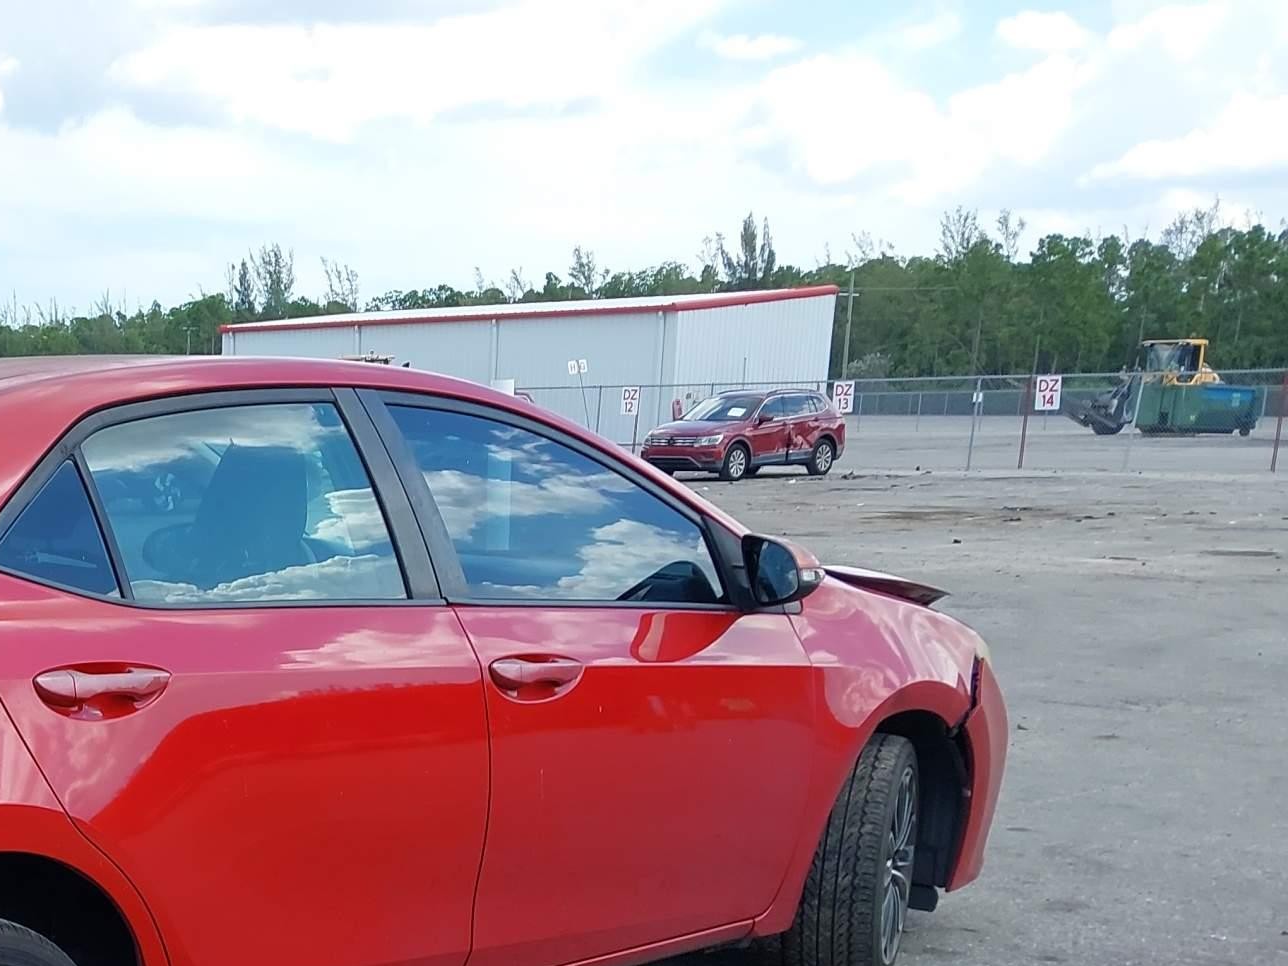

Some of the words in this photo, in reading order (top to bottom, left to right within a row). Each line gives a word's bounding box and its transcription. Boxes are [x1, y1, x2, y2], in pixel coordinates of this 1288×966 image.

[835, 384, 853, 396] DZ
[1038, 379, 1059, 392] DZ
[623, 389, 638, 400] DZ
[1042, 394, 1054, 407] 14
[624, 402, 633, 412] 12
[838, 398, 849, 410] 13
